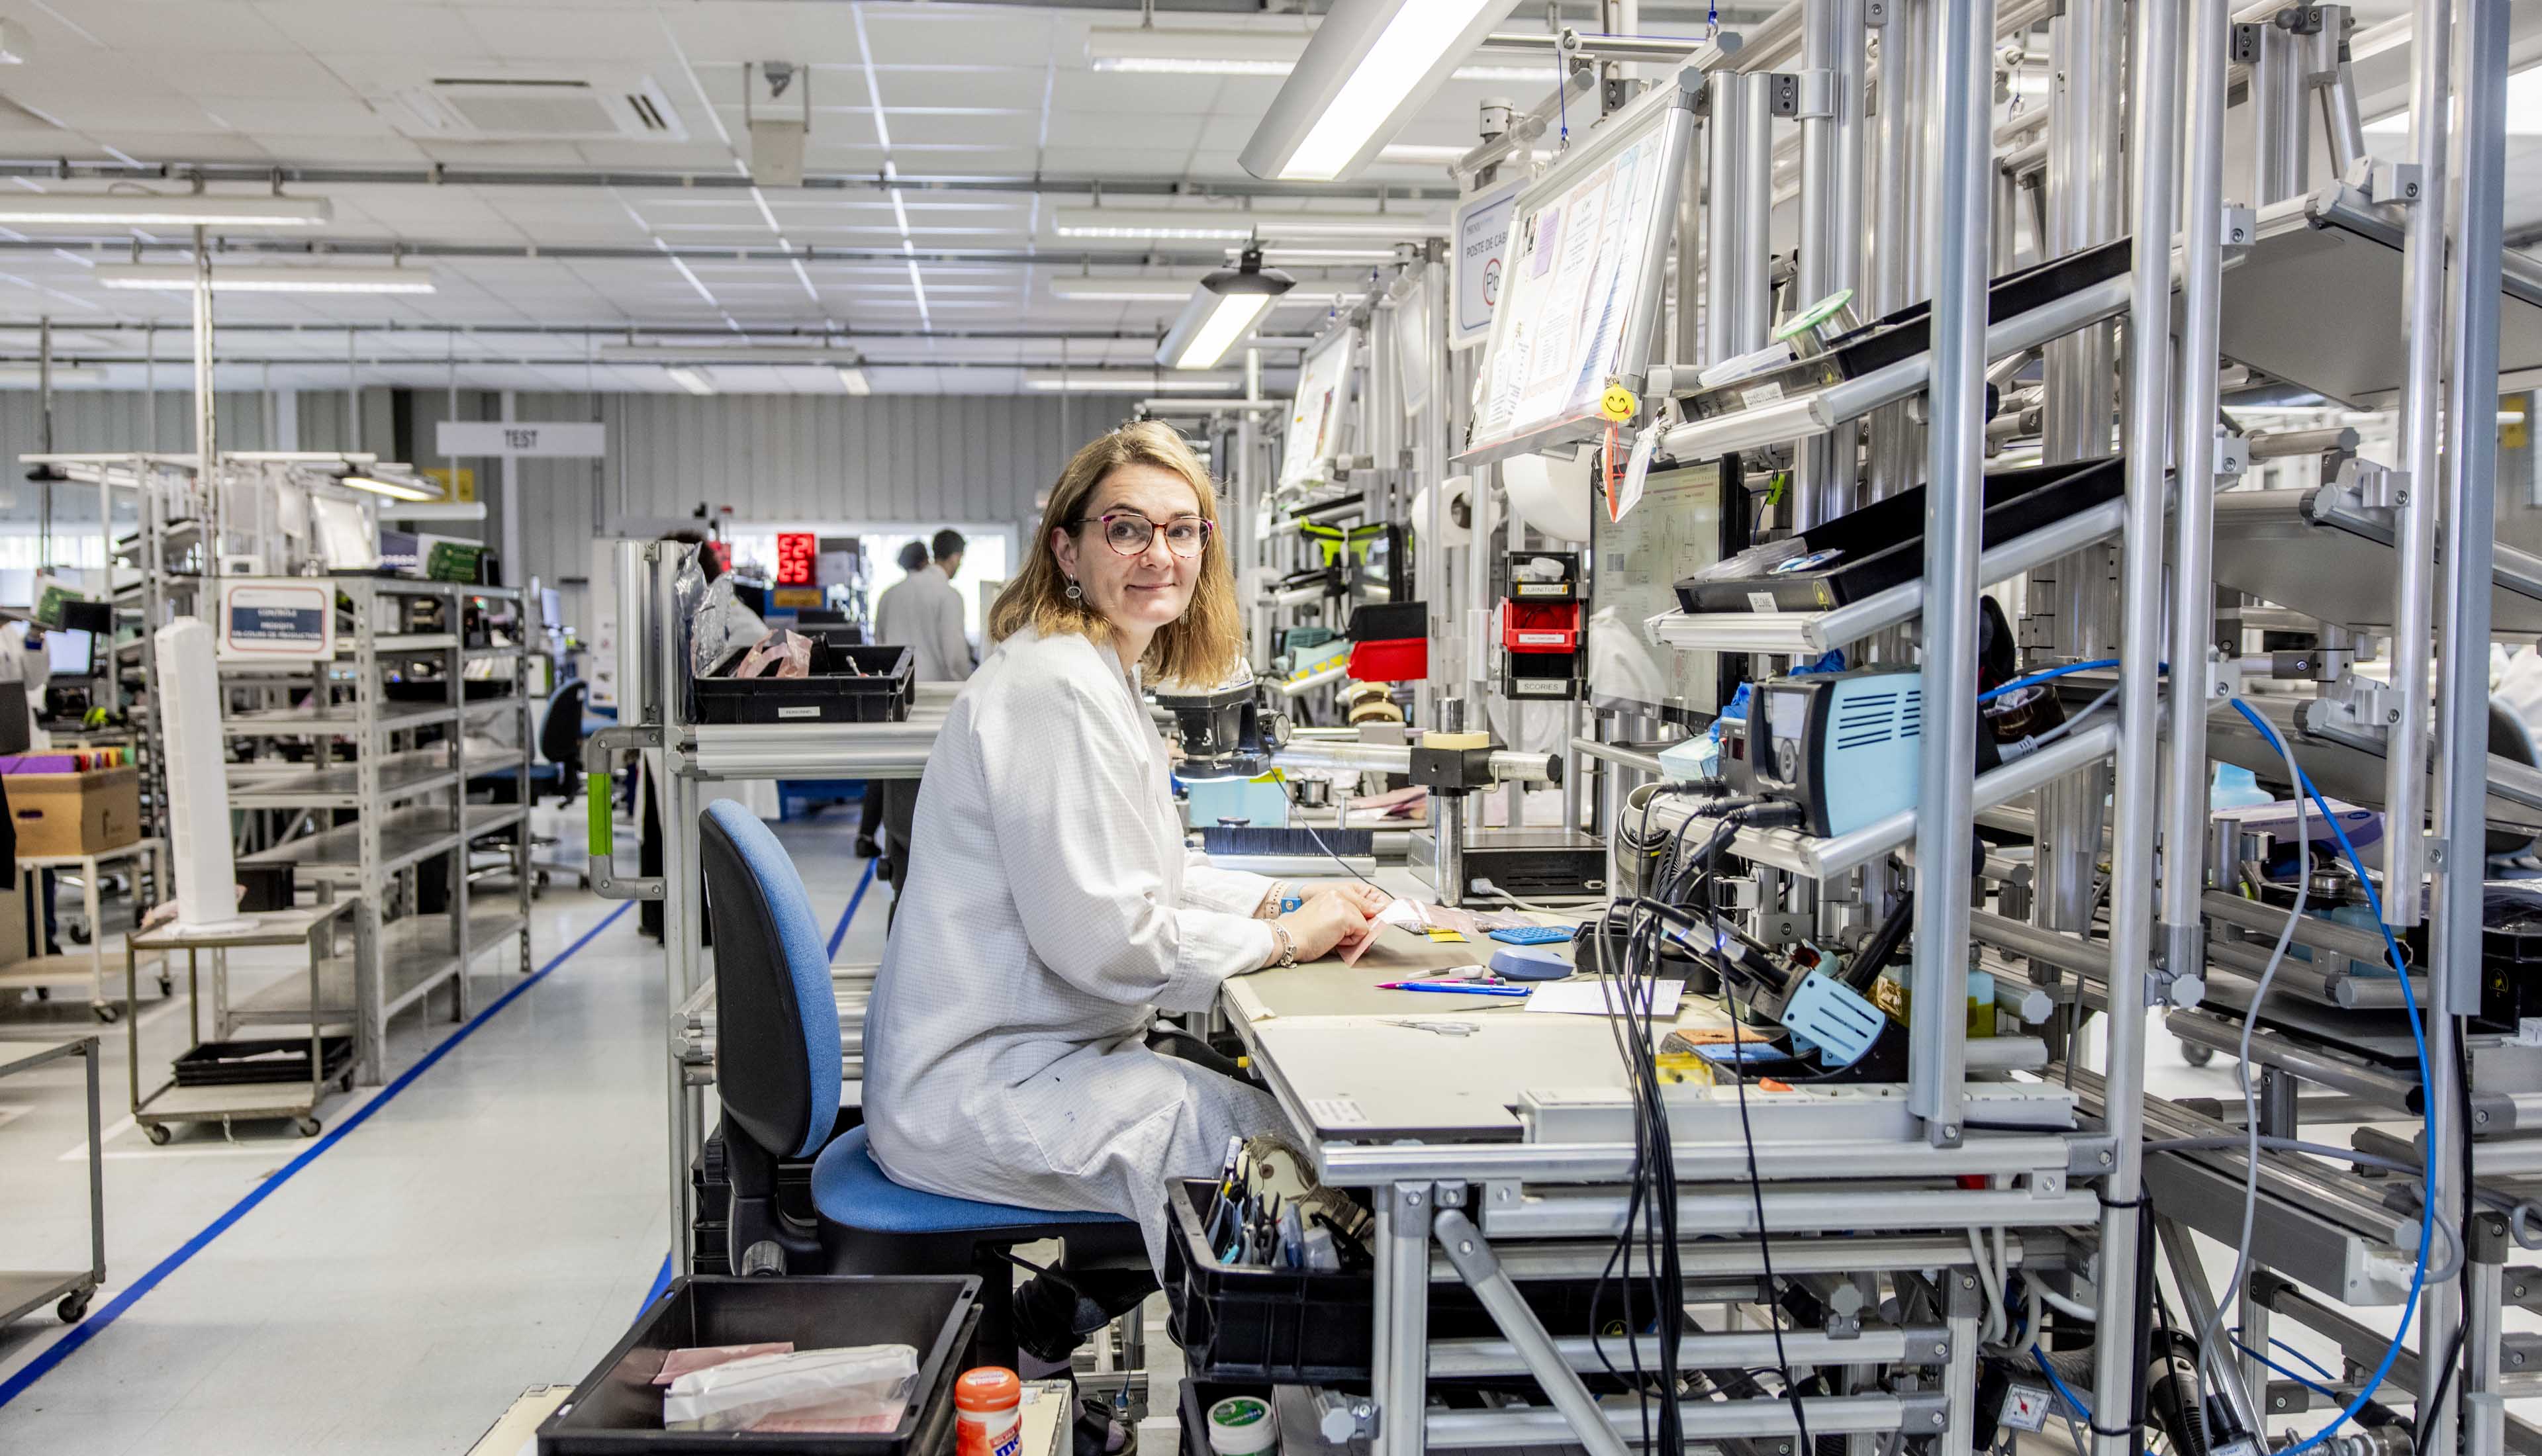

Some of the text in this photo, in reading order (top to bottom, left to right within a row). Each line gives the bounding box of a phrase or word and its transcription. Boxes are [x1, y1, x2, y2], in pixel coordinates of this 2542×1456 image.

[1466, 240, 1484, 258] POSTE
[1485, 237, 1493, 250] DE
[1486, 270, 1499, 294] Pb
[504, 429, 538, 449] TEST
